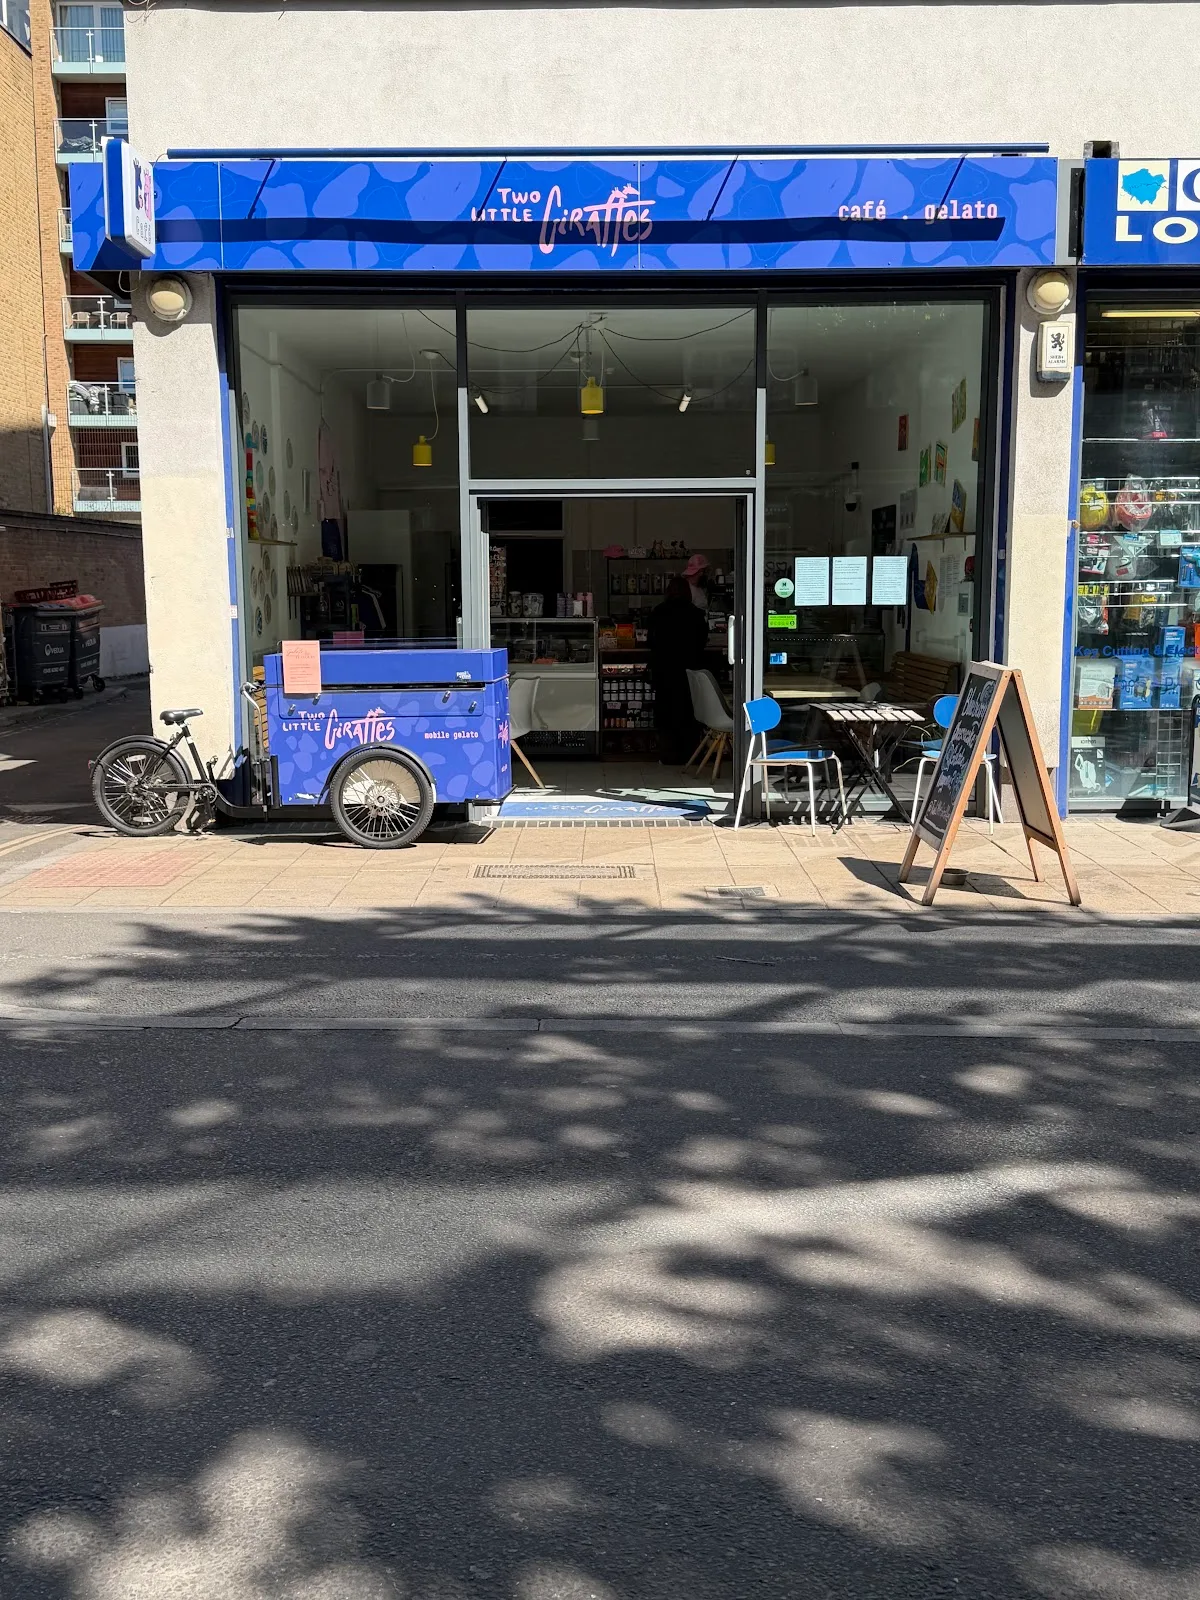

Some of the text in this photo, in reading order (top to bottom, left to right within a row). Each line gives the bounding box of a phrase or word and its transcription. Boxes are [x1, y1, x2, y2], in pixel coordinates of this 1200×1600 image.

[471, 207, 533, 222] LITTLE
[838, 199, 998, 225] café gelato
[1074, 645, 1099, 658] Key
[1102, 645, 1150, 658] Cutting
[282, 722, 321, 732] LITTLE
[424, 730, 479, 741] mobile gelato
